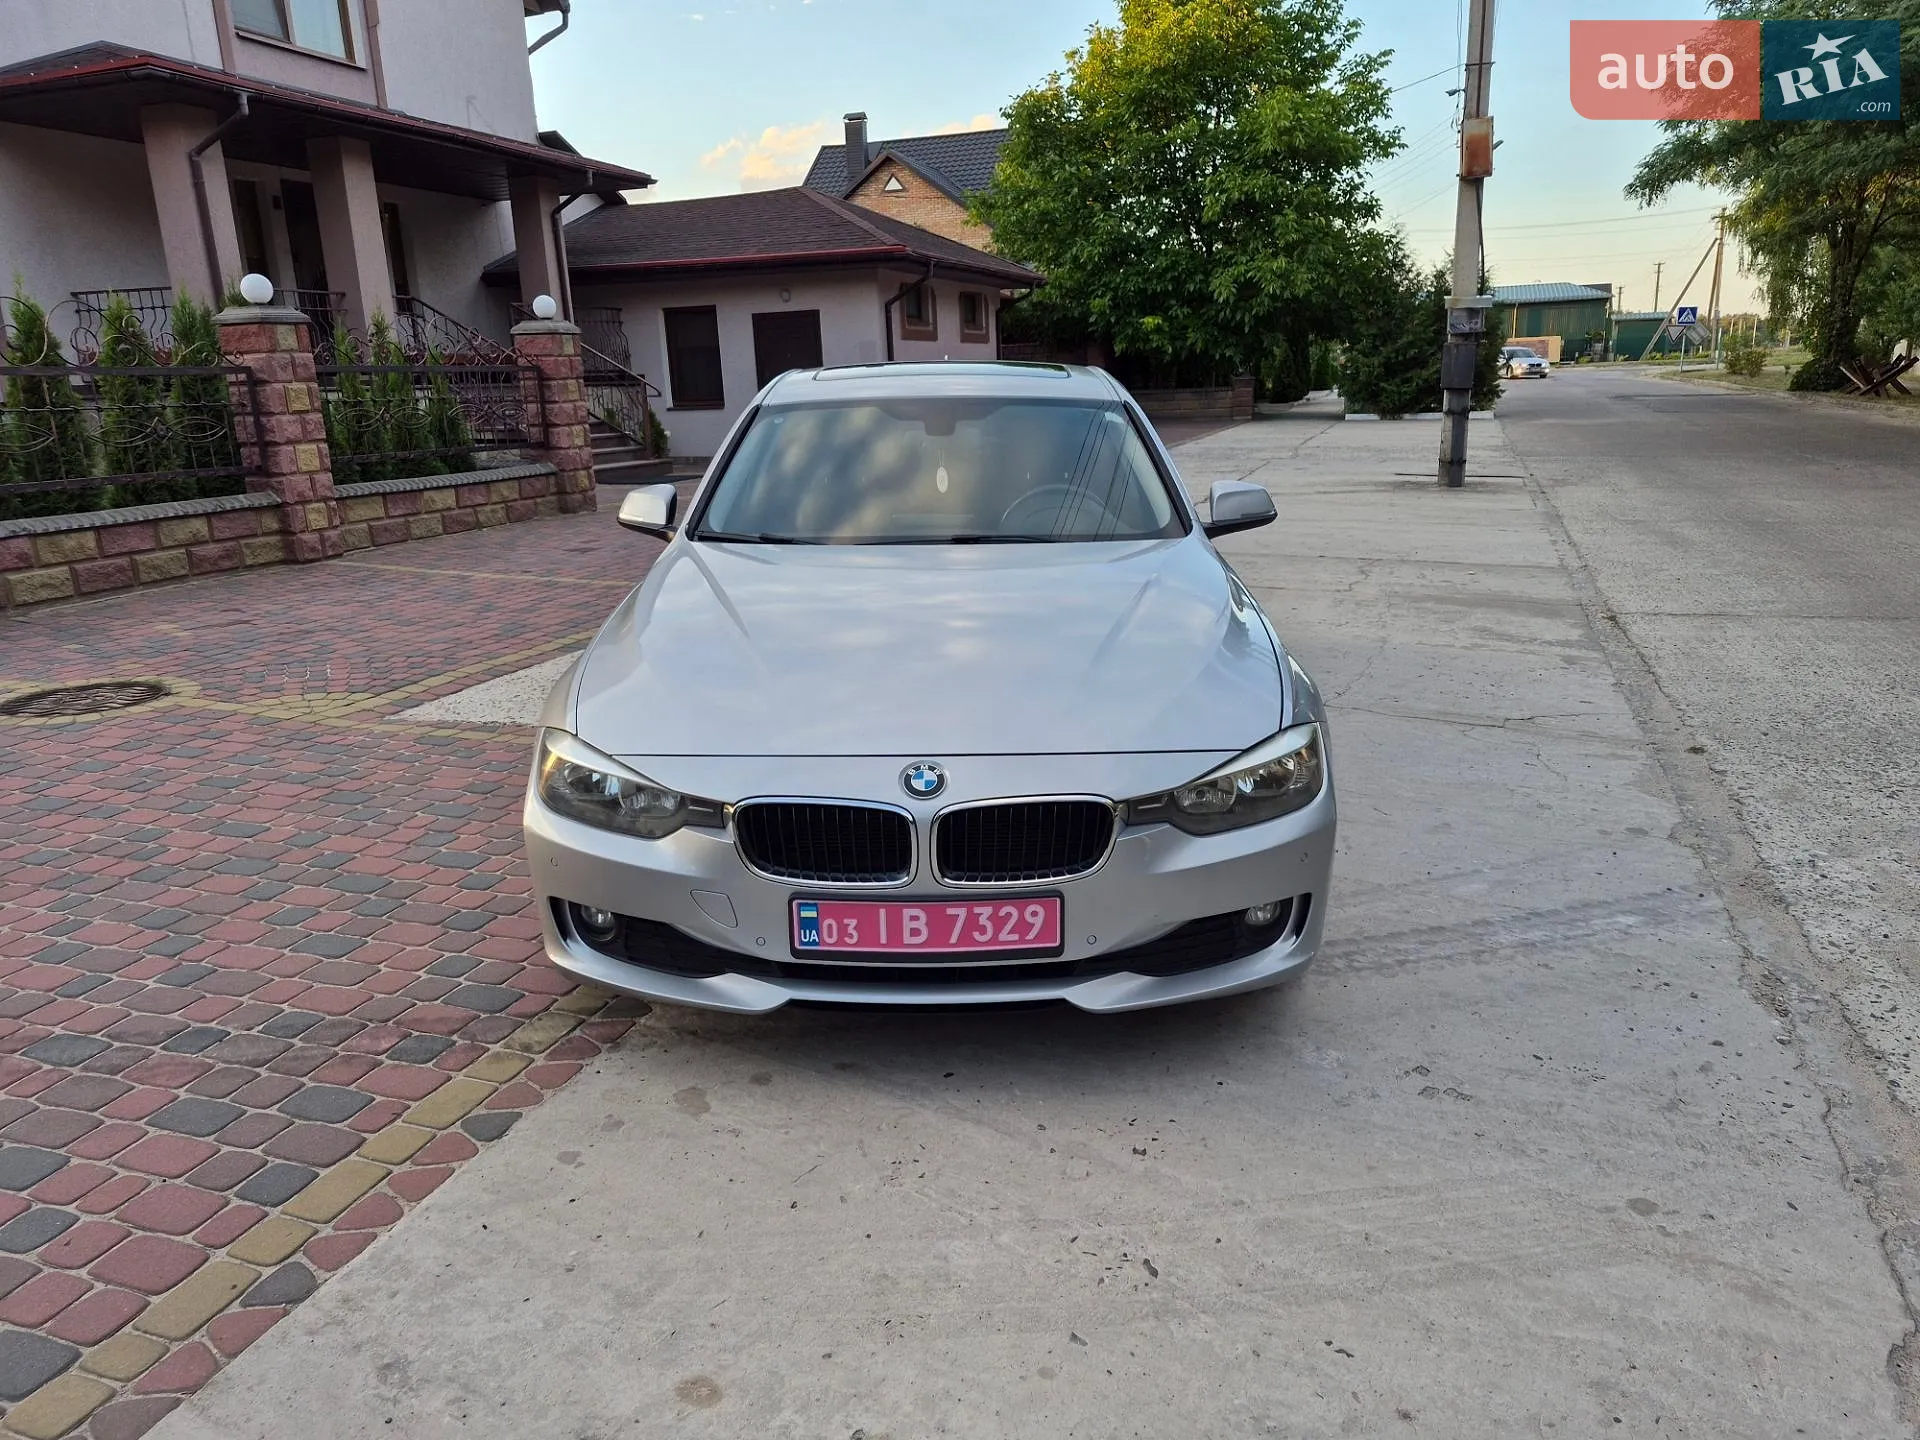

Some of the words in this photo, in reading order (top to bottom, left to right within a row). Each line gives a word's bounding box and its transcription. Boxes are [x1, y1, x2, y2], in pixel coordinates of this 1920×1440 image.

[800, 929, 819, 943] UA
[822, 918, 858, 944] 03
[879, 908, 928, 944] IB
[946, 904, 1046, 944] 7329
